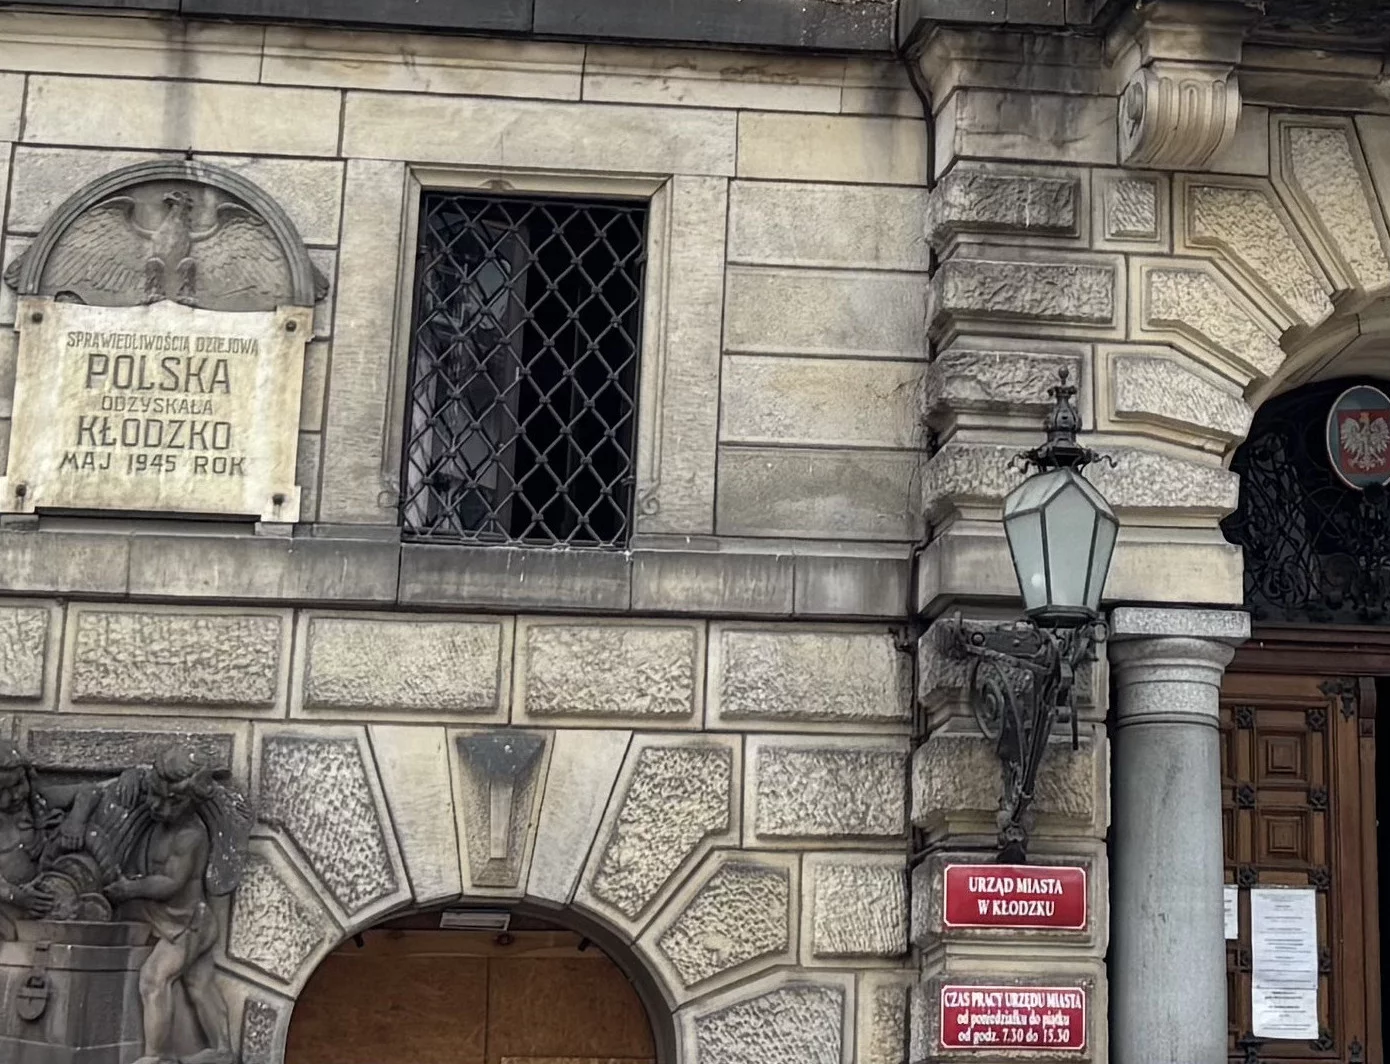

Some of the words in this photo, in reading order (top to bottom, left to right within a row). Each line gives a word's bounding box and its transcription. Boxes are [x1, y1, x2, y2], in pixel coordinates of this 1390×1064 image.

[85, 353, 231, 394] POLSKA
[102, 395, 213, 415] ODZYSKAŁA
[76, 415, 231, 451] KŁODZKO
[58, 451, 112, 471] MAJ
[126, 453, 177, 474] 1945
[194, 455, 247, 476] ROK
[968, 876, 1014, 896] URZĄD
[1016, 877, 1063, 895] MIASTA
[977, 899, 990, 915] W
[992, 899, 1055, 917] KŁODZKU
[944, 991, 970, 1007] CZAS
[971, 991, 1004, 1008] PRACY
[1005, 992, 1046, 1010] URZĘDU
[1046, 992, 1081, 1009] MIASTA
[956, 1008, 969, 1025] od
[1028, 1009, 1041, 1025] do
[957, 1026, 971, 1041] od
[973, 1027, 1000, 1044] godz.
[1001, 1028, 1025, 1043] 7.30
[1025, 1027, 1039, 1043] do
[1042, 1028, 1070, 1043] 15.30
